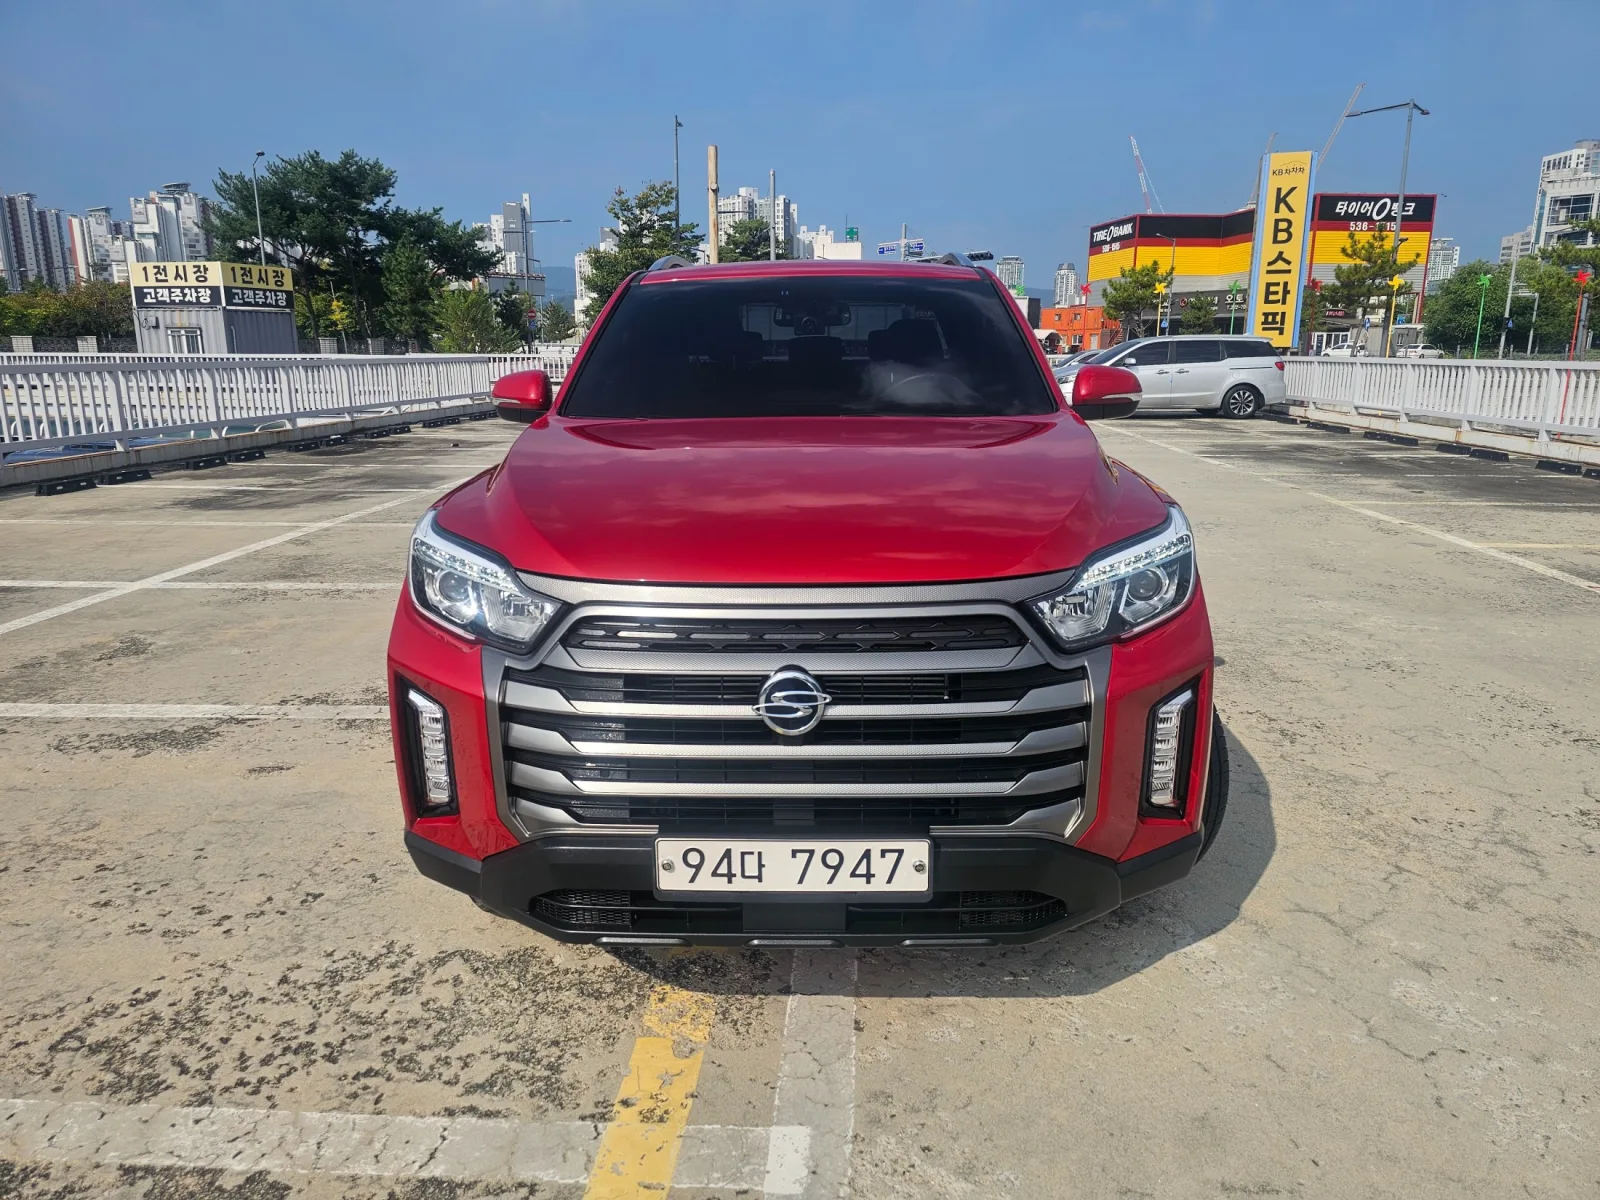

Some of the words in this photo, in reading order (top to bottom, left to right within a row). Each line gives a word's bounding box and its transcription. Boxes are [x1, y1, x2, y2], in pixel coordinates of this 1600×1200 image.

[143, 288, 211, 303] 고객주차장
[232, 288, 287, 306] 고객주차장
[681, 847, 766, 885] 94다
[791, 848, 905, 885] 7947
